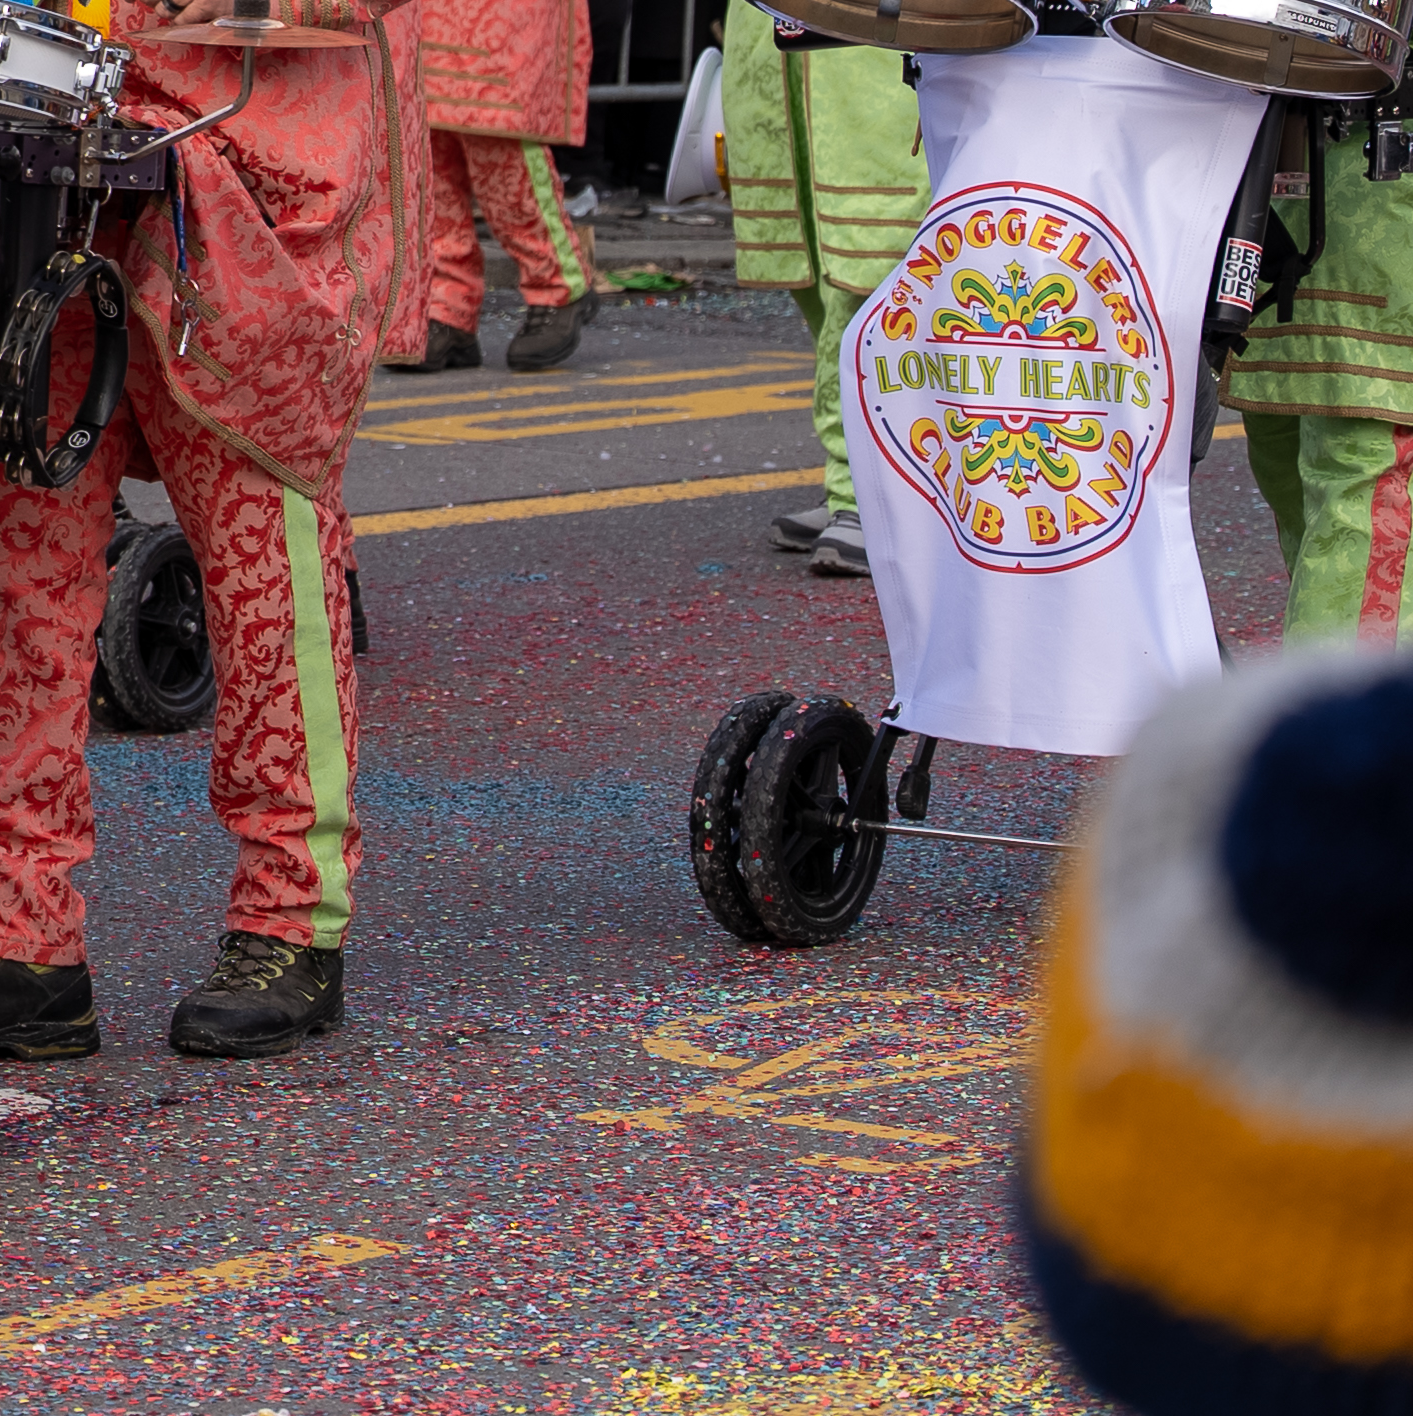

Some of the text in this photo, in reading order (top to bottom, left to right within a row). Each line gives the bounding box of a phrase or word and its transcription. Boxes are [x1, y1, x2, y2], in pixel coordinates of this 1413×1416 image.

[907, 208, 1148, 359] NOGGELERS
[875, 350, 1151, 410] LONELY HEARTS
[910, 418, 1135, 546] CLUB BAND
